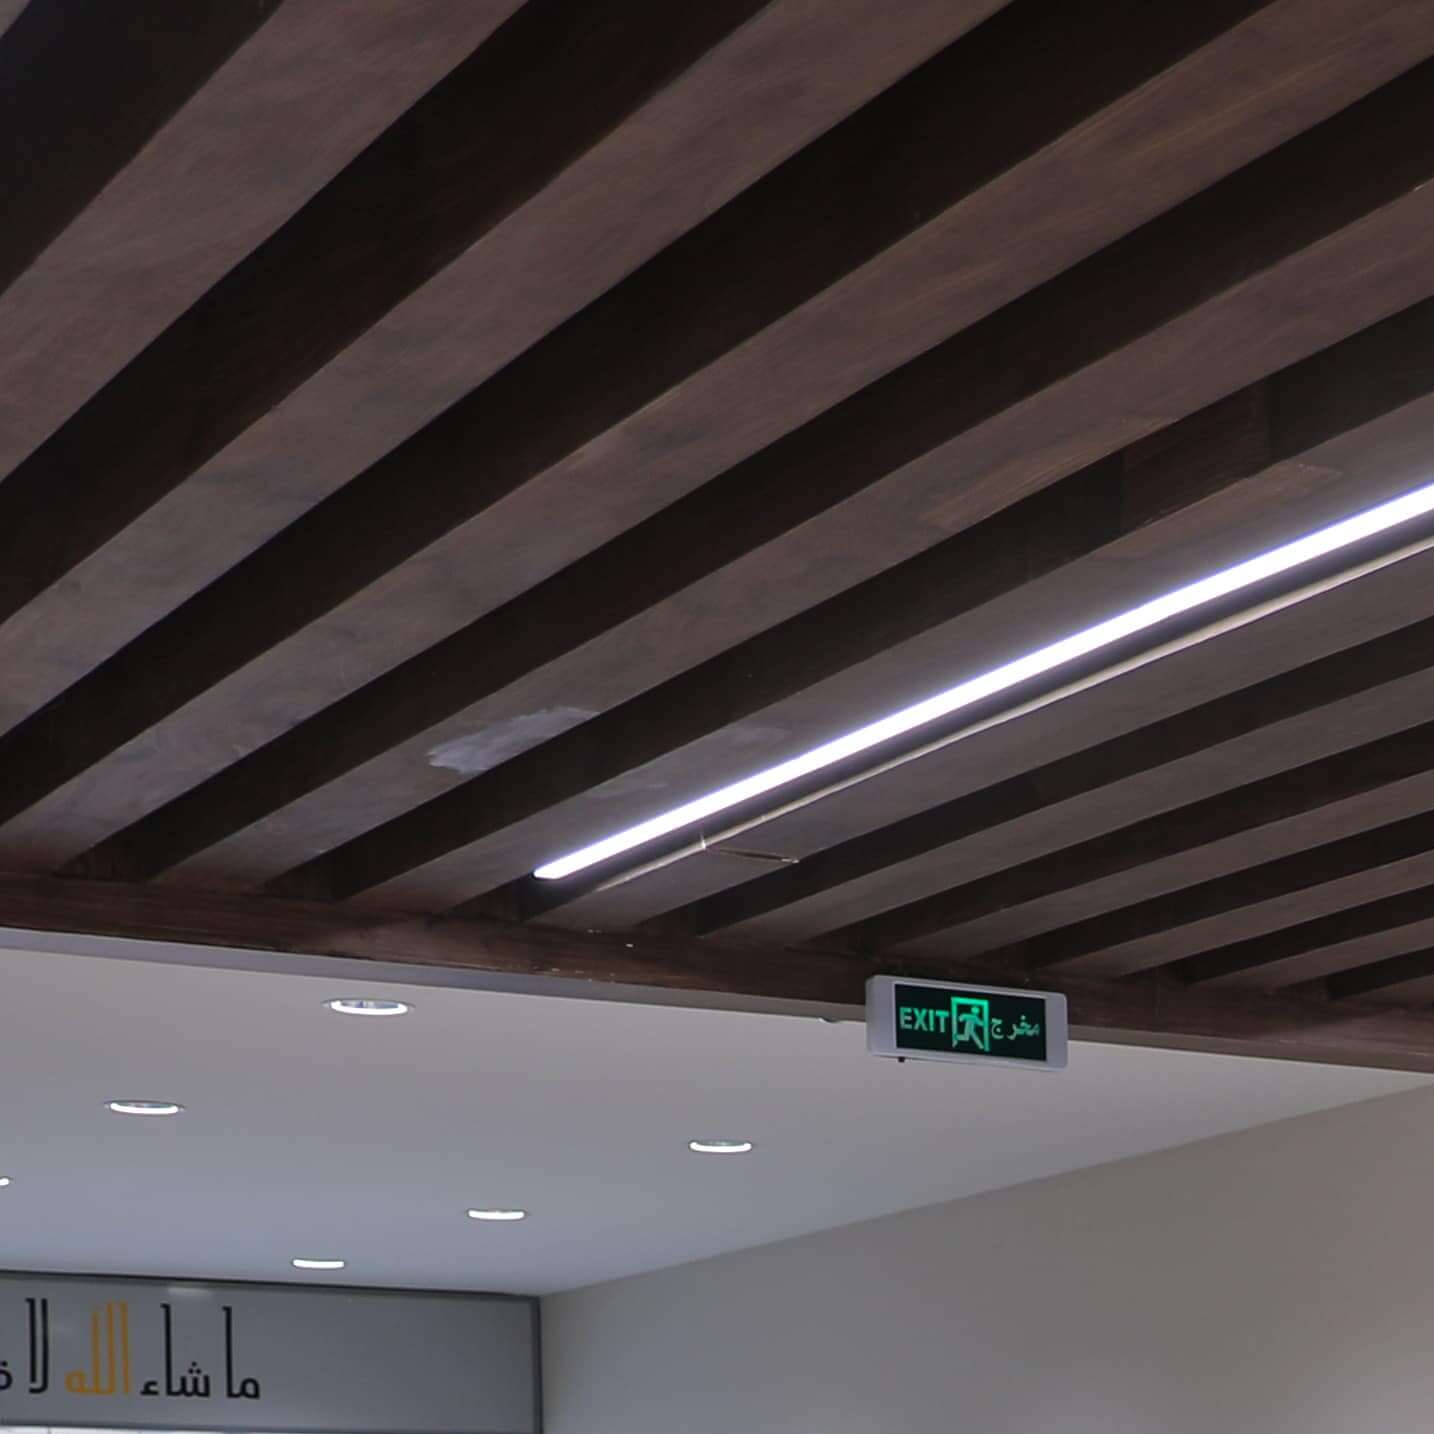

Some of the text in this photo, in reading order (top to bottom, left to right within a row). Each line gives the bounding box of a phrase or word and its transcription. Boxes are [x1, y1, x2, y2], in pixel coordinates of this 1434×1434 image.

[899, 1006, 950, 1033] EXIT
[991, 1014, 1041, 1041] مخرج
[63, 1300, 131, 1396] الله
